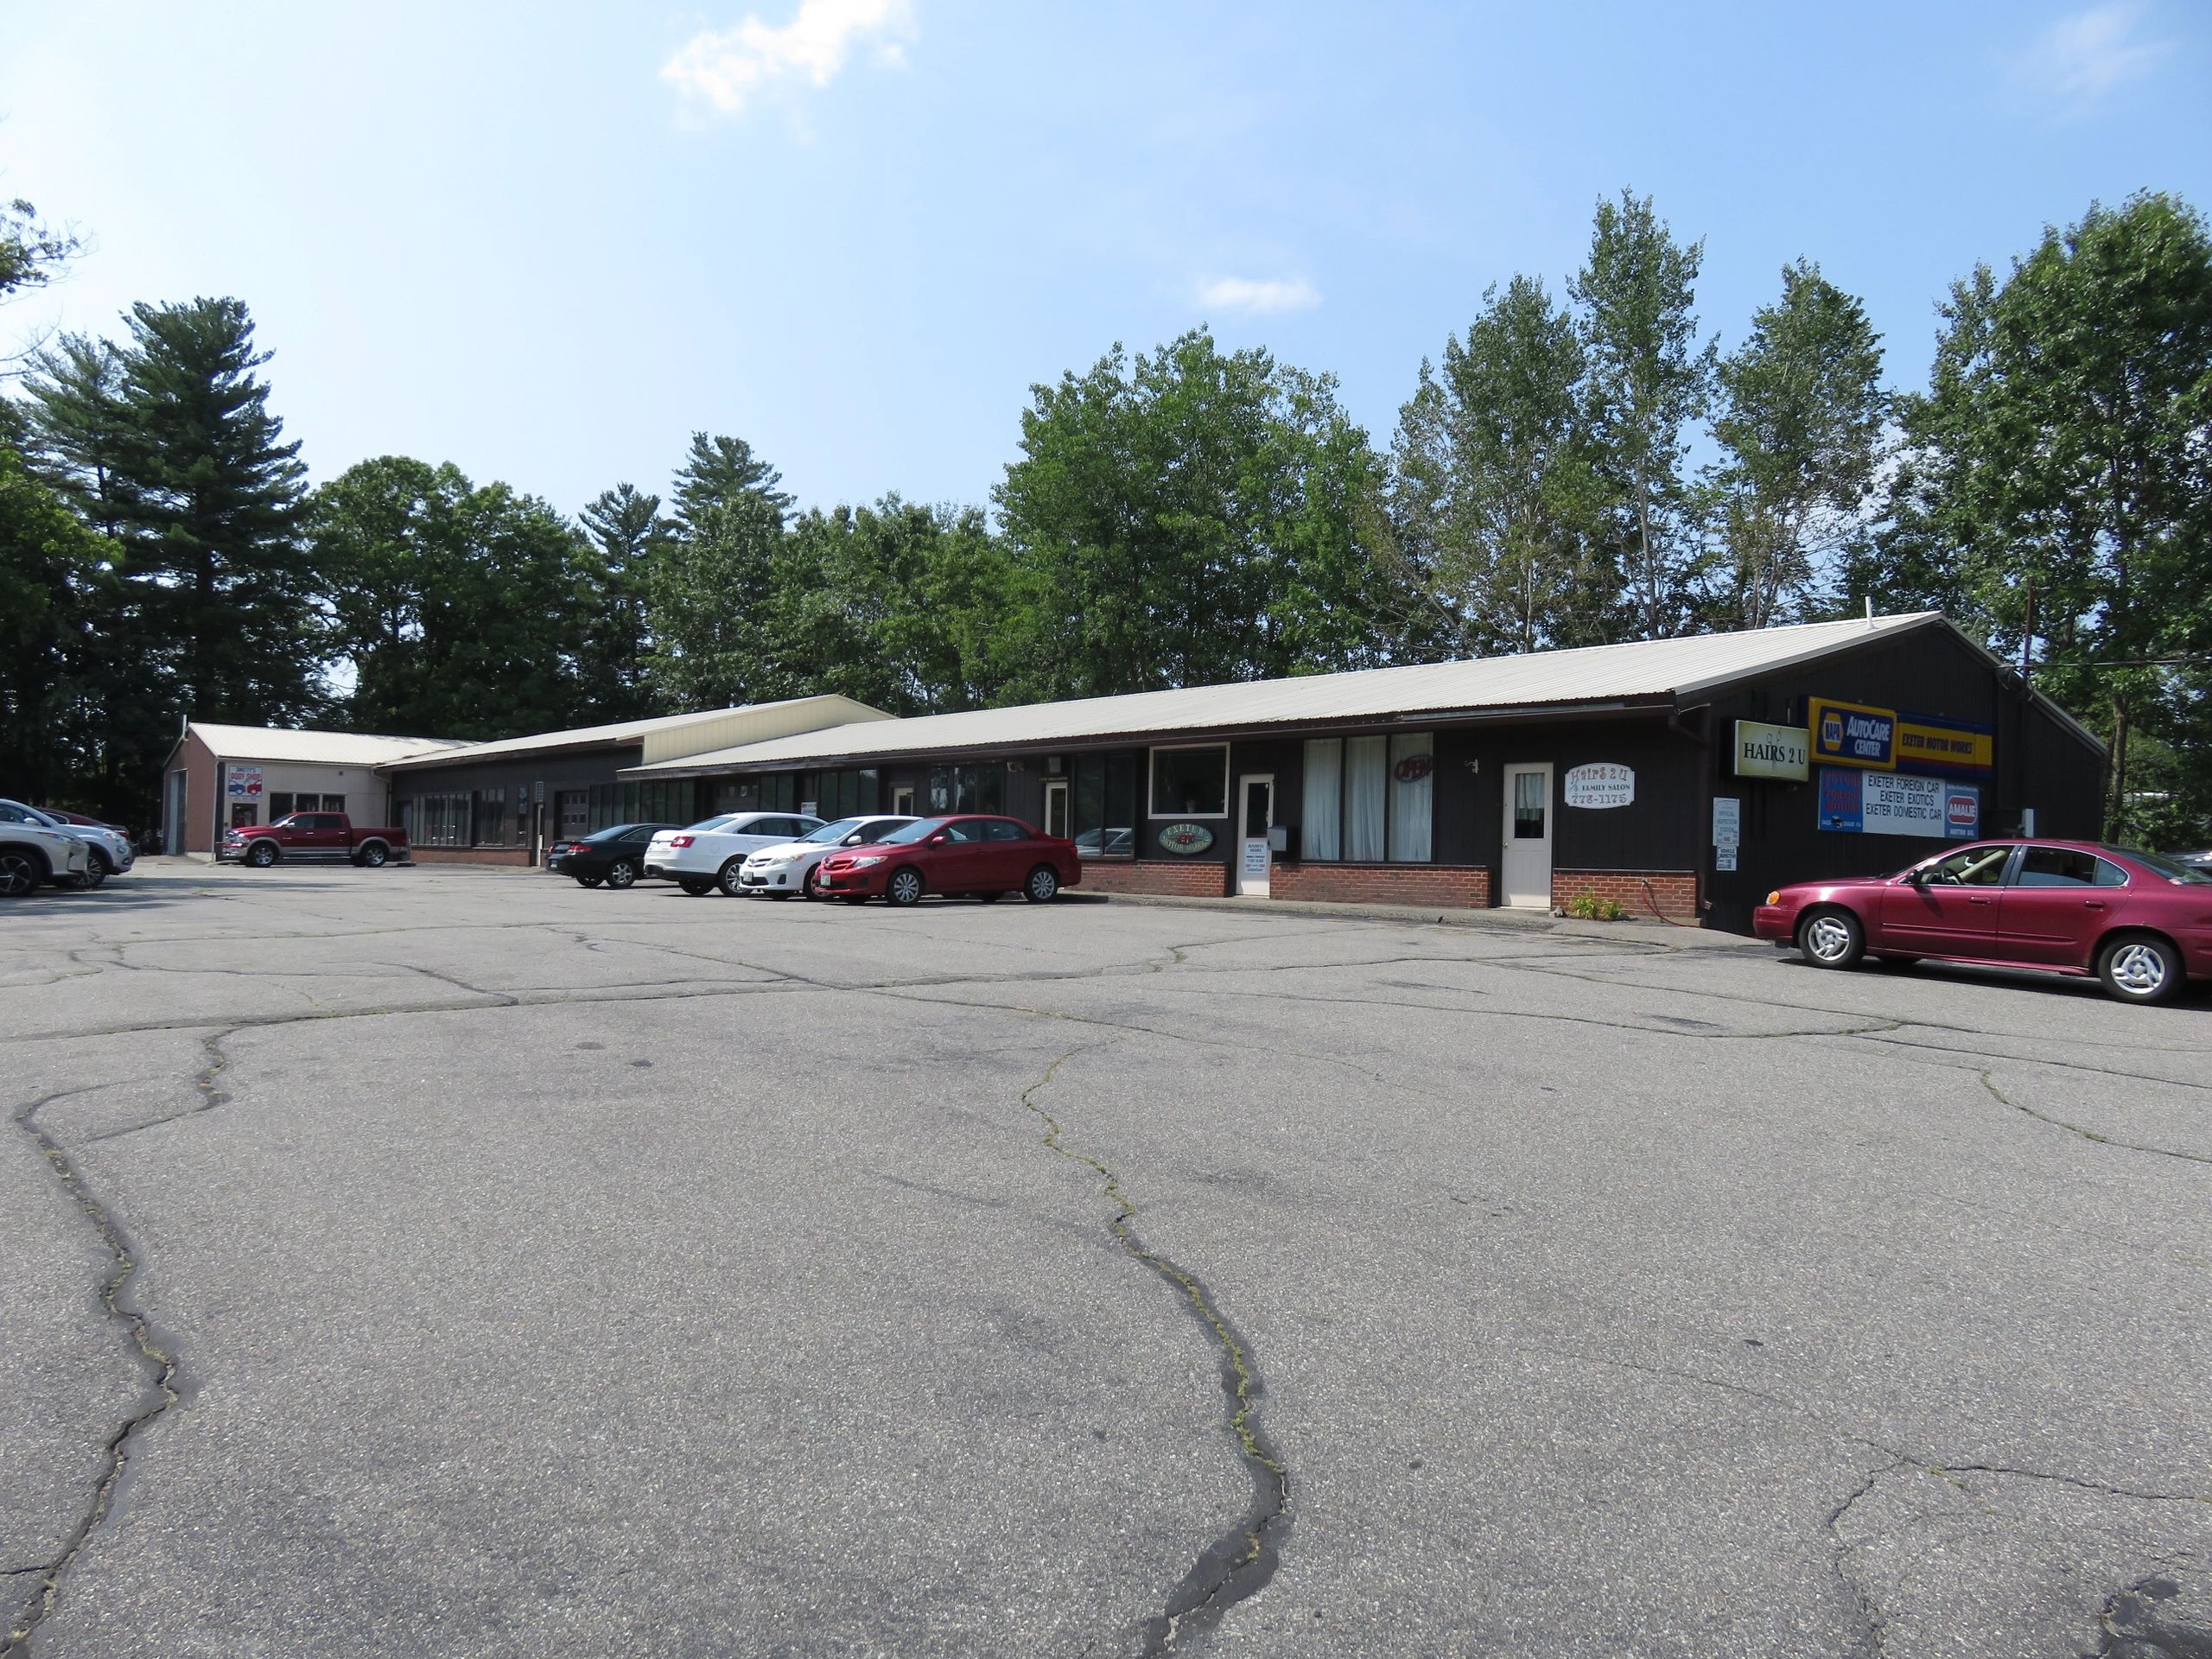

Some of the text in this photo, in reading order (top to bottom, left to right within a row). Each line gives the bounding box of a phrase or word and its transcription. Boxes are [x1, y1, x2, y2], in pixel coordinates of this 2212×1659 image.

[1854, 739, 1880, 757] CENTER
[1902, 733, 1973, 754] EXETER MOTOR WORKS
[1744, 742, 1806, 765] HAIRS 2 U
[1395, 760, 1429, 779] OPEN
[1610, 767, 1617, 780] 2
[1868, 774, 1894, 789] EXETER
[1897, 778, 1925, 792] FOREIGN
[1927, 781, 1940, 794] CAR
[1572, 793, 1628, 804] 778-1175
[1880, 790, 1935, 807] EXETER EXOTICS
[1866, 803, 1942, 821] EXETER DOMESTIC CAR
[1948, 802, 1977, 817] AMALIE
[1166, 823, 1204, 836] EXETER
[1161, 836, 1210, 851] MOTOR WORKS
